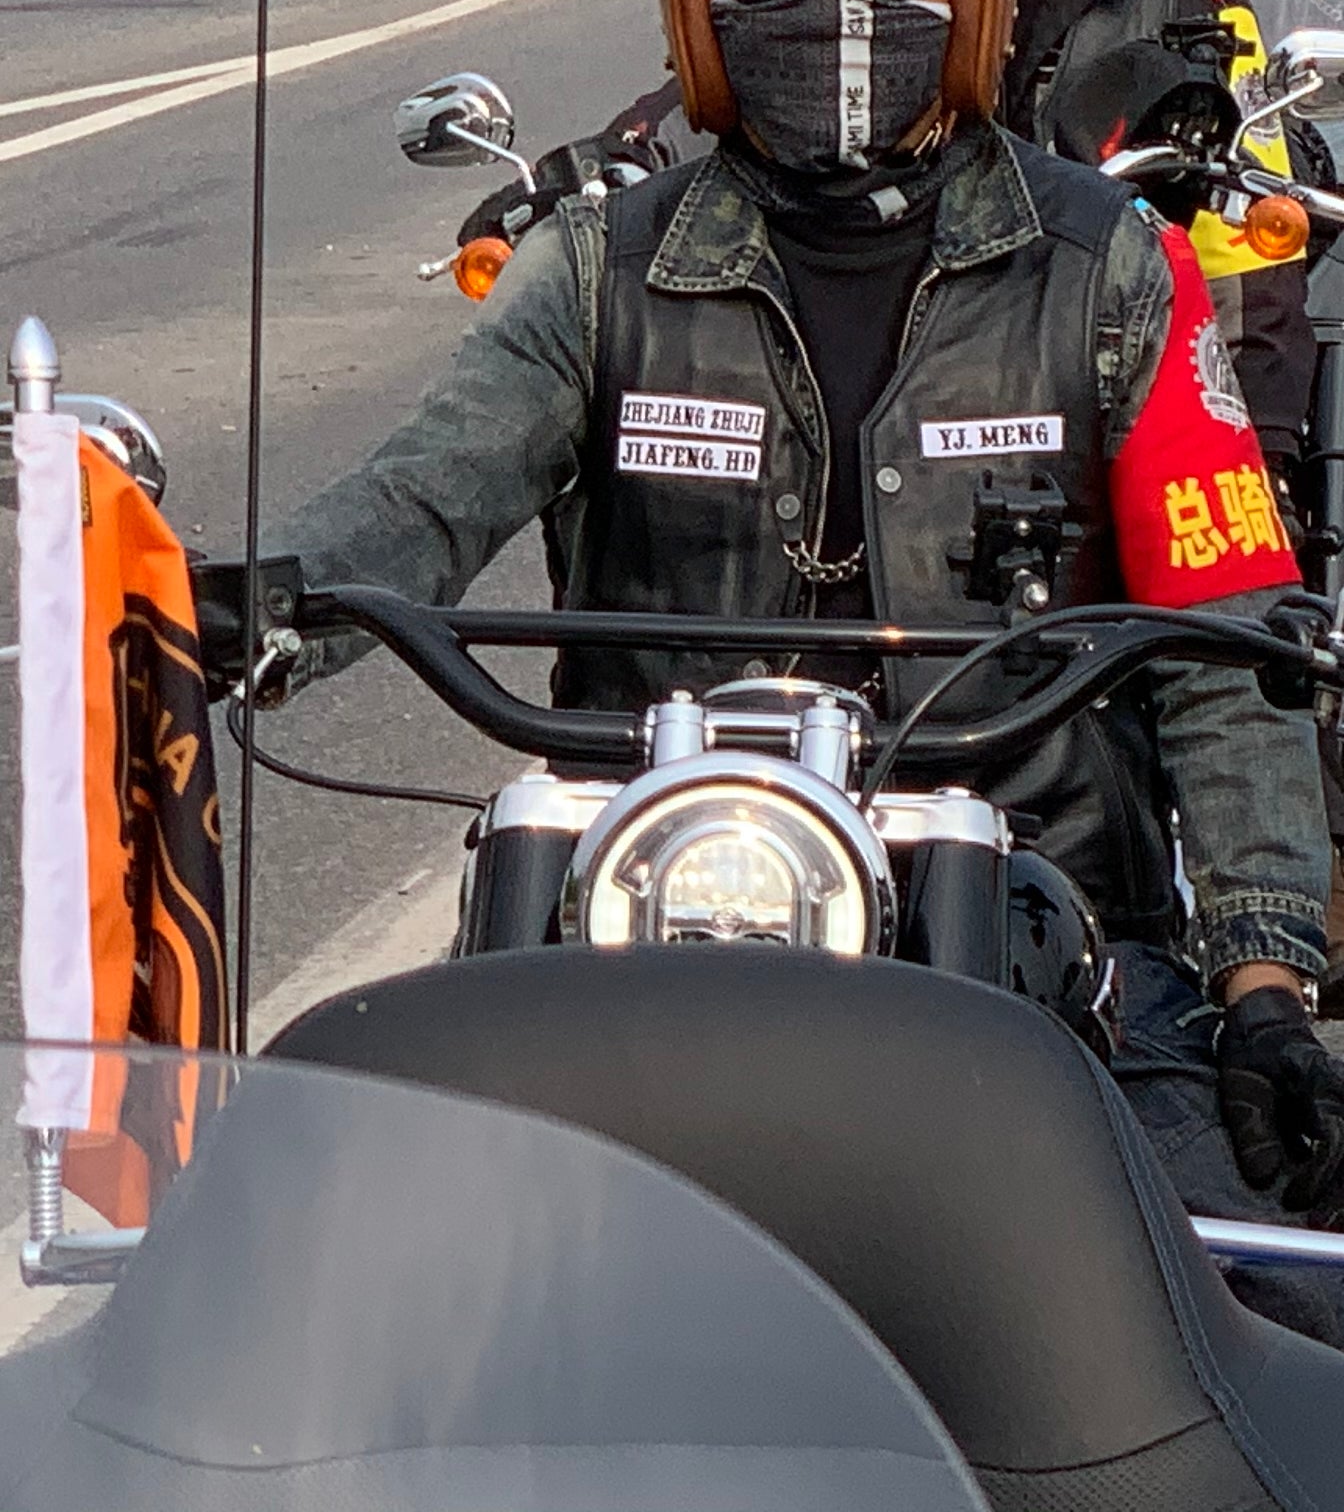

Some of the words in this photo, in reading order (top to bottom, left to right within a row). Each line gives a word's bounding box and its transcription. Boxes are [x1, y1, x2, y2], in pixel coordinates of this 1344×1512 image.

[847, 85, 864, 121] TIME
[622, 401, 705, 429] ZHEJIANG
[710, 408, 765, 435] ZHUJI
[938, 428, 973, 451] YJ.
[979, 422, 1049, 448] MENG
[621, 442, 720, 471] JIAFENG.
[725, 449, 757, 473] HD
